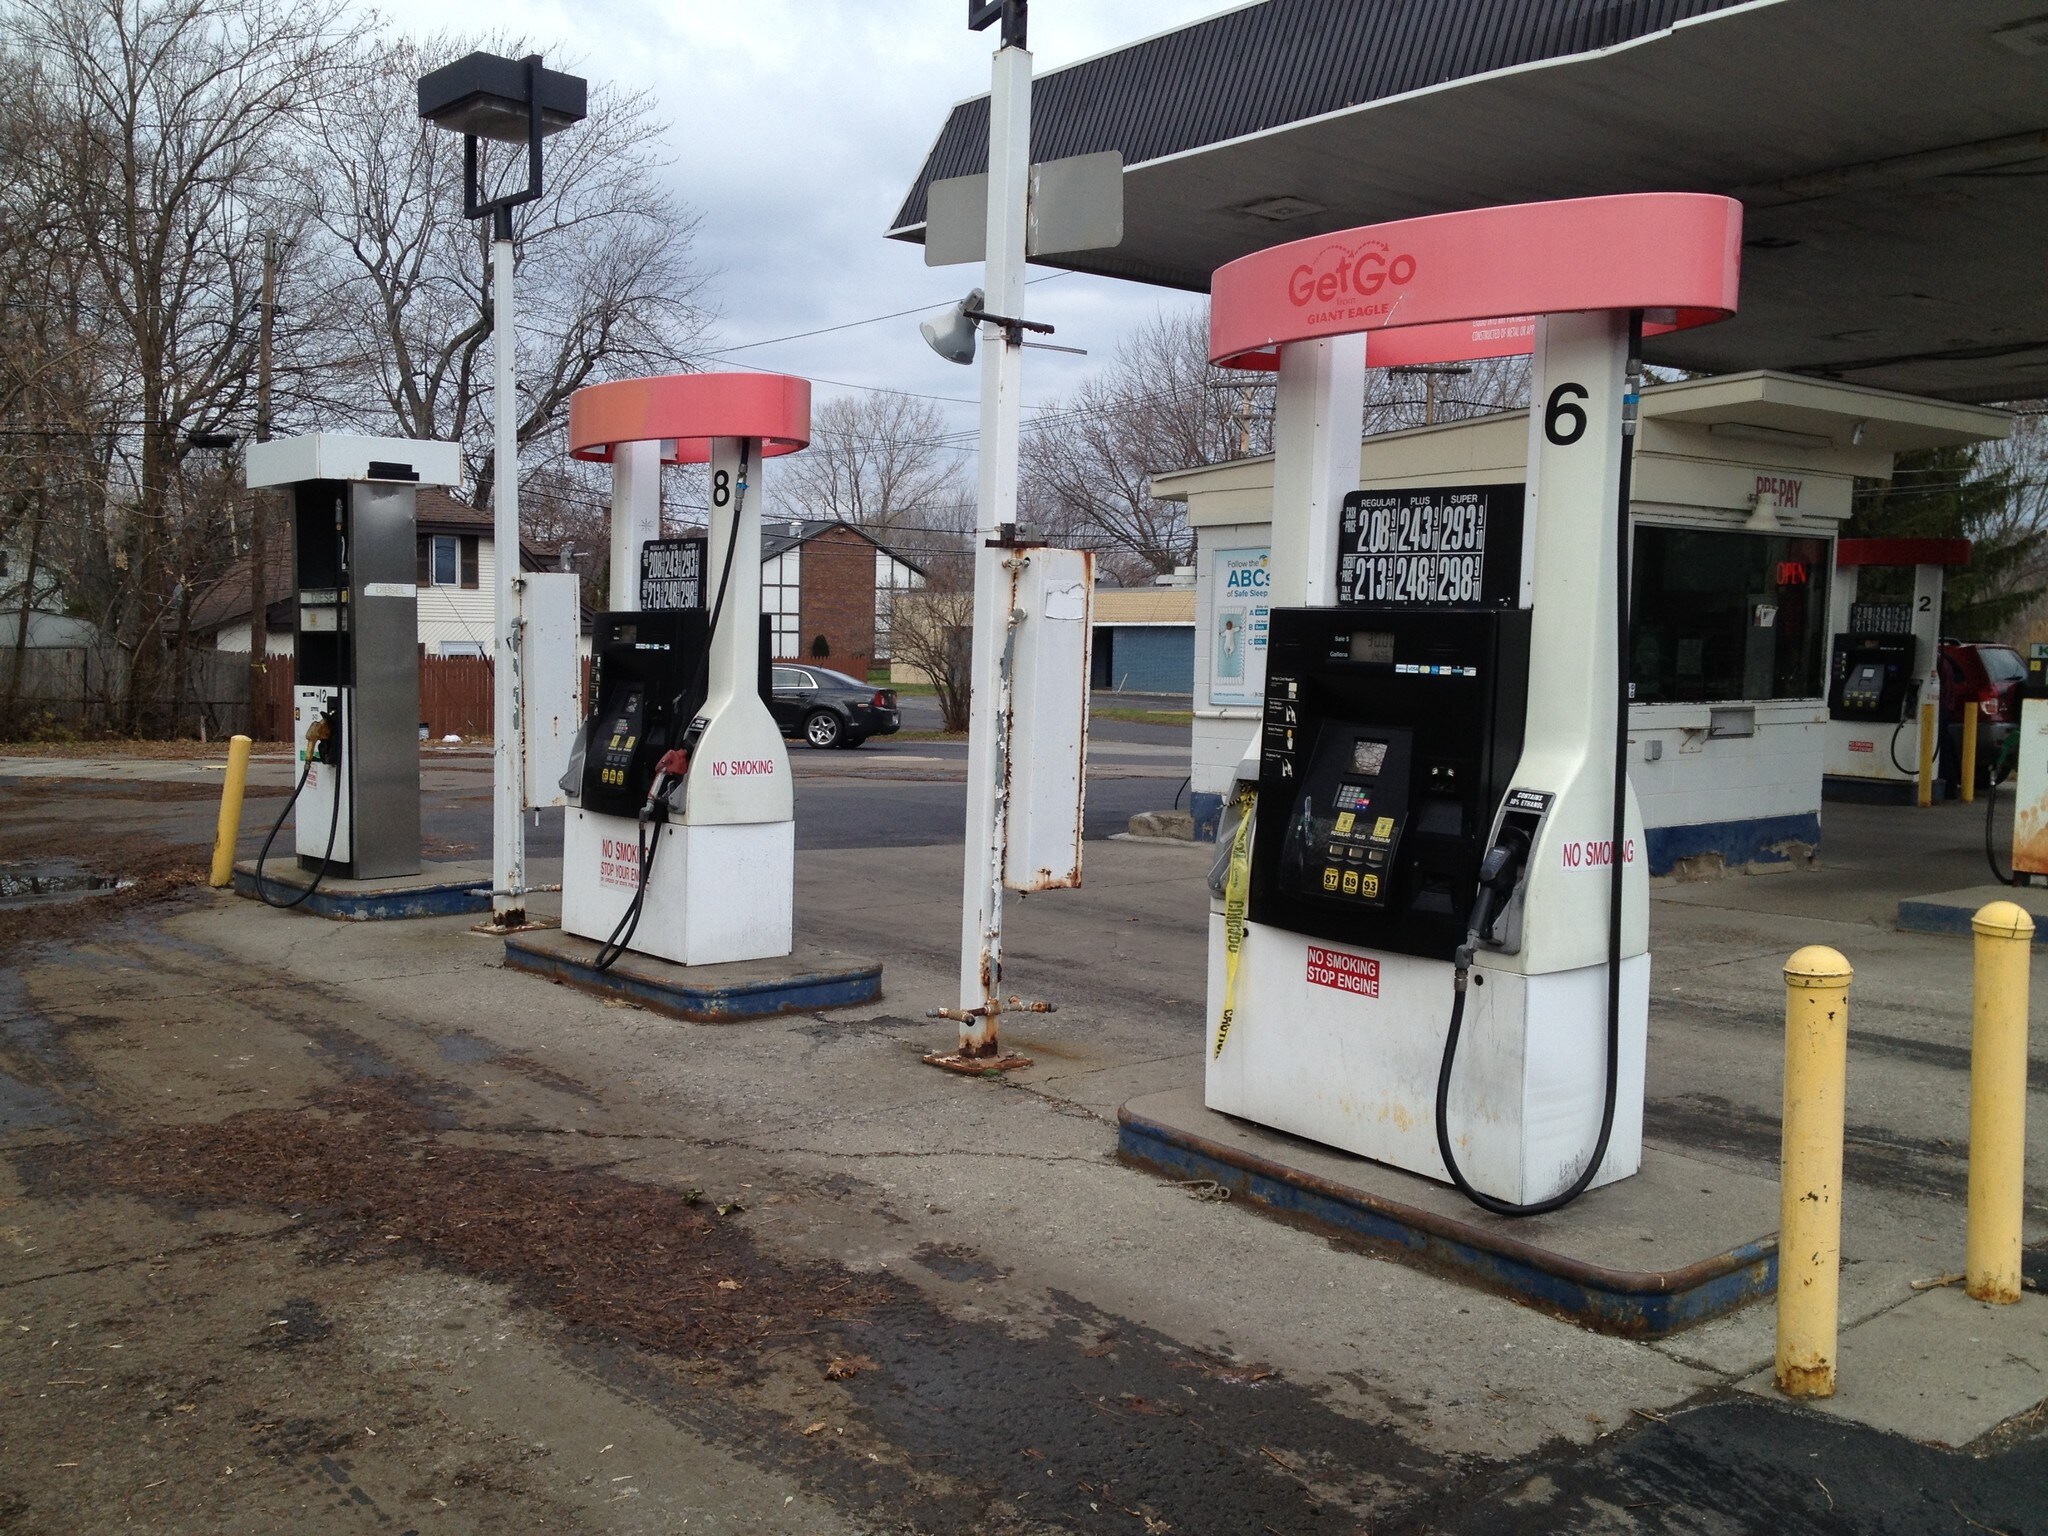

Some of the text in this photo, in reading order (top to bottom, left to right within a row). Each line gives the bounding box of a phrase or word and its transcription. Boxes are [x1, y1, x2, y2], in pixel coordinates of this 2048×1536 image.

[1289, 252, 1417, 307] GetGo
[1307, 303, 1389, 325] GIANT EAGLE
[1545, 382, 1589, 446] 6
[713, 469, 730, 507] 8
[1361, 494, 1478, 507] REGULAR PLUS SUPER
[1228, 560, 1248, 568] Follow
[1777, 562, 1807, 585] OPEN
[1250, 589, 1268, 598] Sleep
[1919, 596, 1931, 612] 2
[713, 759, 773, 776] NO SMOKING
[1517, 792, 1543, 801] CONTAINS
[1520, 799, 1543, 809] ETHANOL
[602, 839, 613, 858] NO
[1562, 842, 1581, 867] NO
[601, 861, 614, 876] STOP
[1325, 874, 1376, 891] 87 89 93
[1308, 948, 1376, 977] NO SMOKING
[1308, 965, 1378, 996] STOP ENGINE
